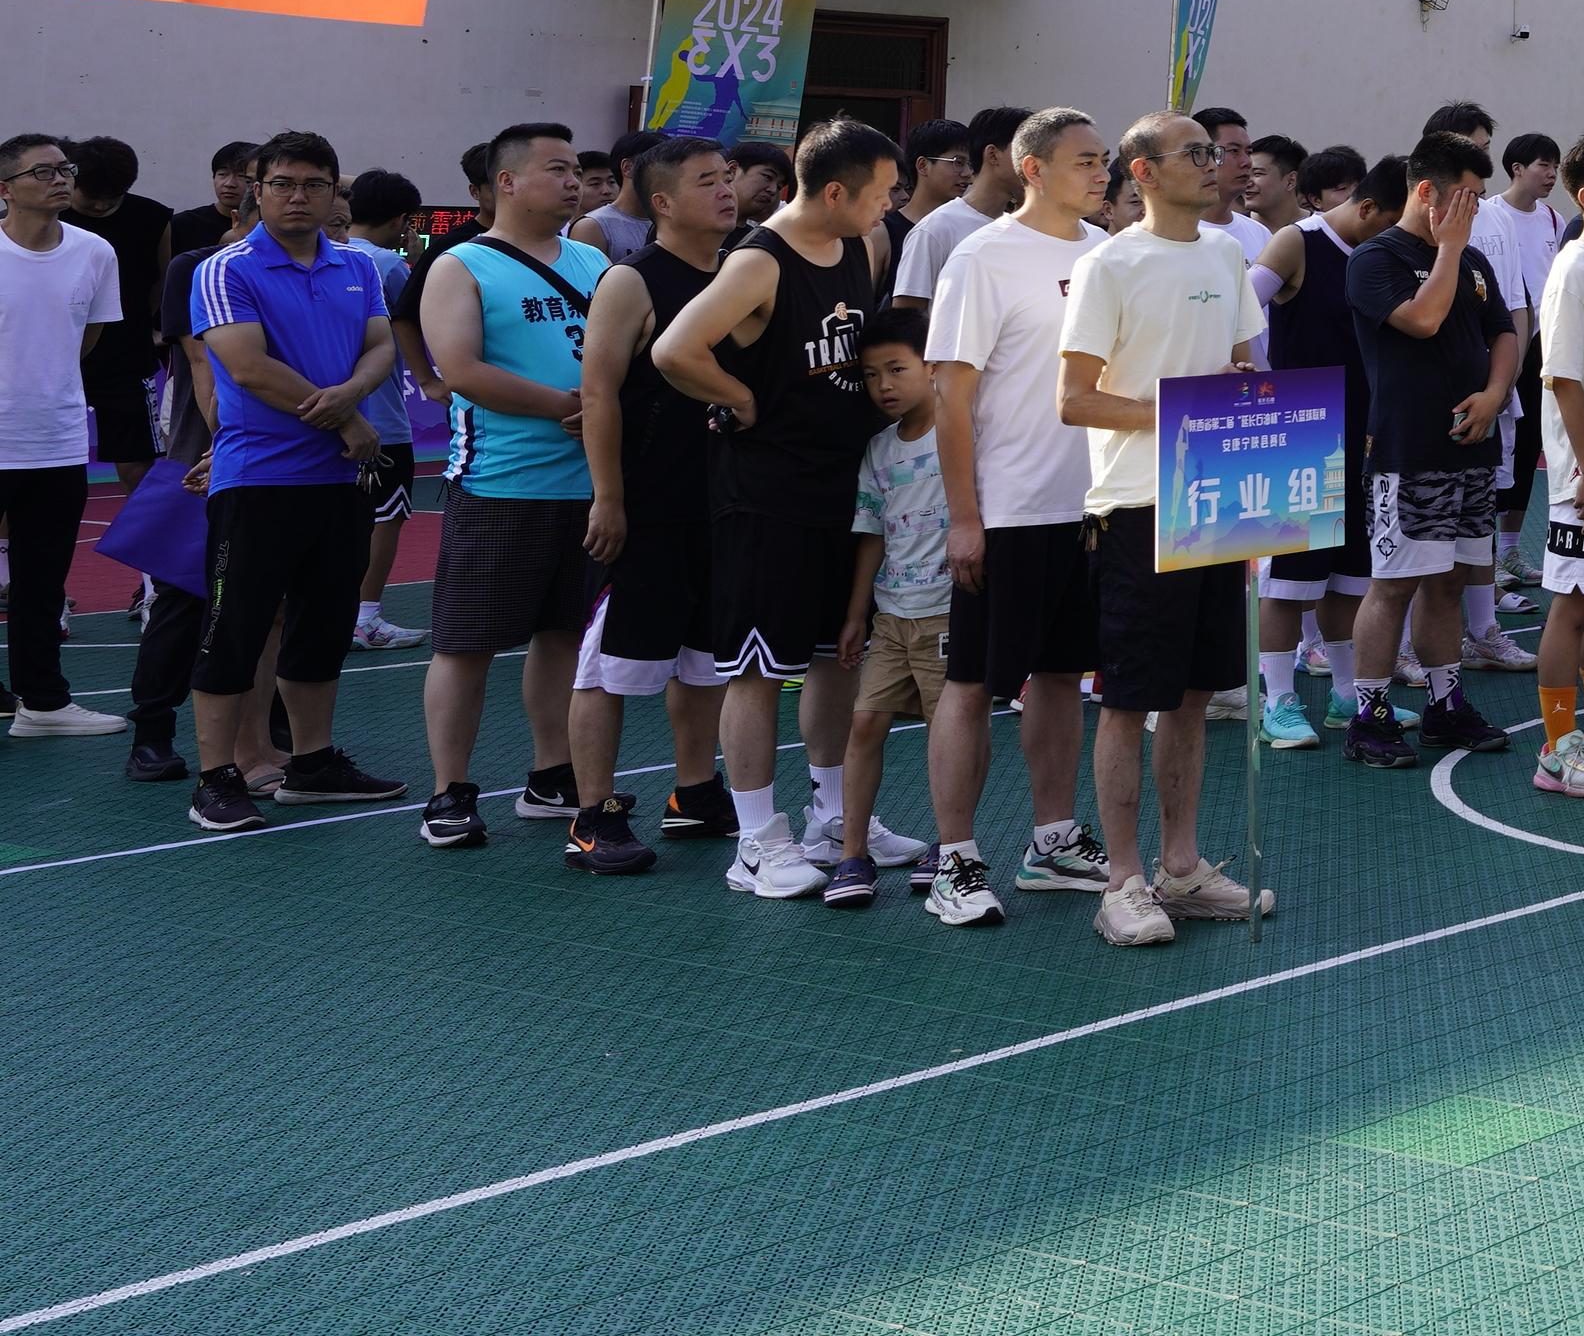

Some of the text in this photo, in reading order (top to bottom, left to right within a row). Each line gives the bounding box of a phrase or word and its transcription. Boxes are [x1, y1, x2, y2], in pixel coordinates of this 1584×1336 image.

[1188, 415, 1235, 433] 陕西省第二届
[1284, 407, 1327, 424] 三人篮球联赛
[1222, 433, 1287, 453] 安康宁陕县赛区
[1188, 467, 1318, 526] 行业组
